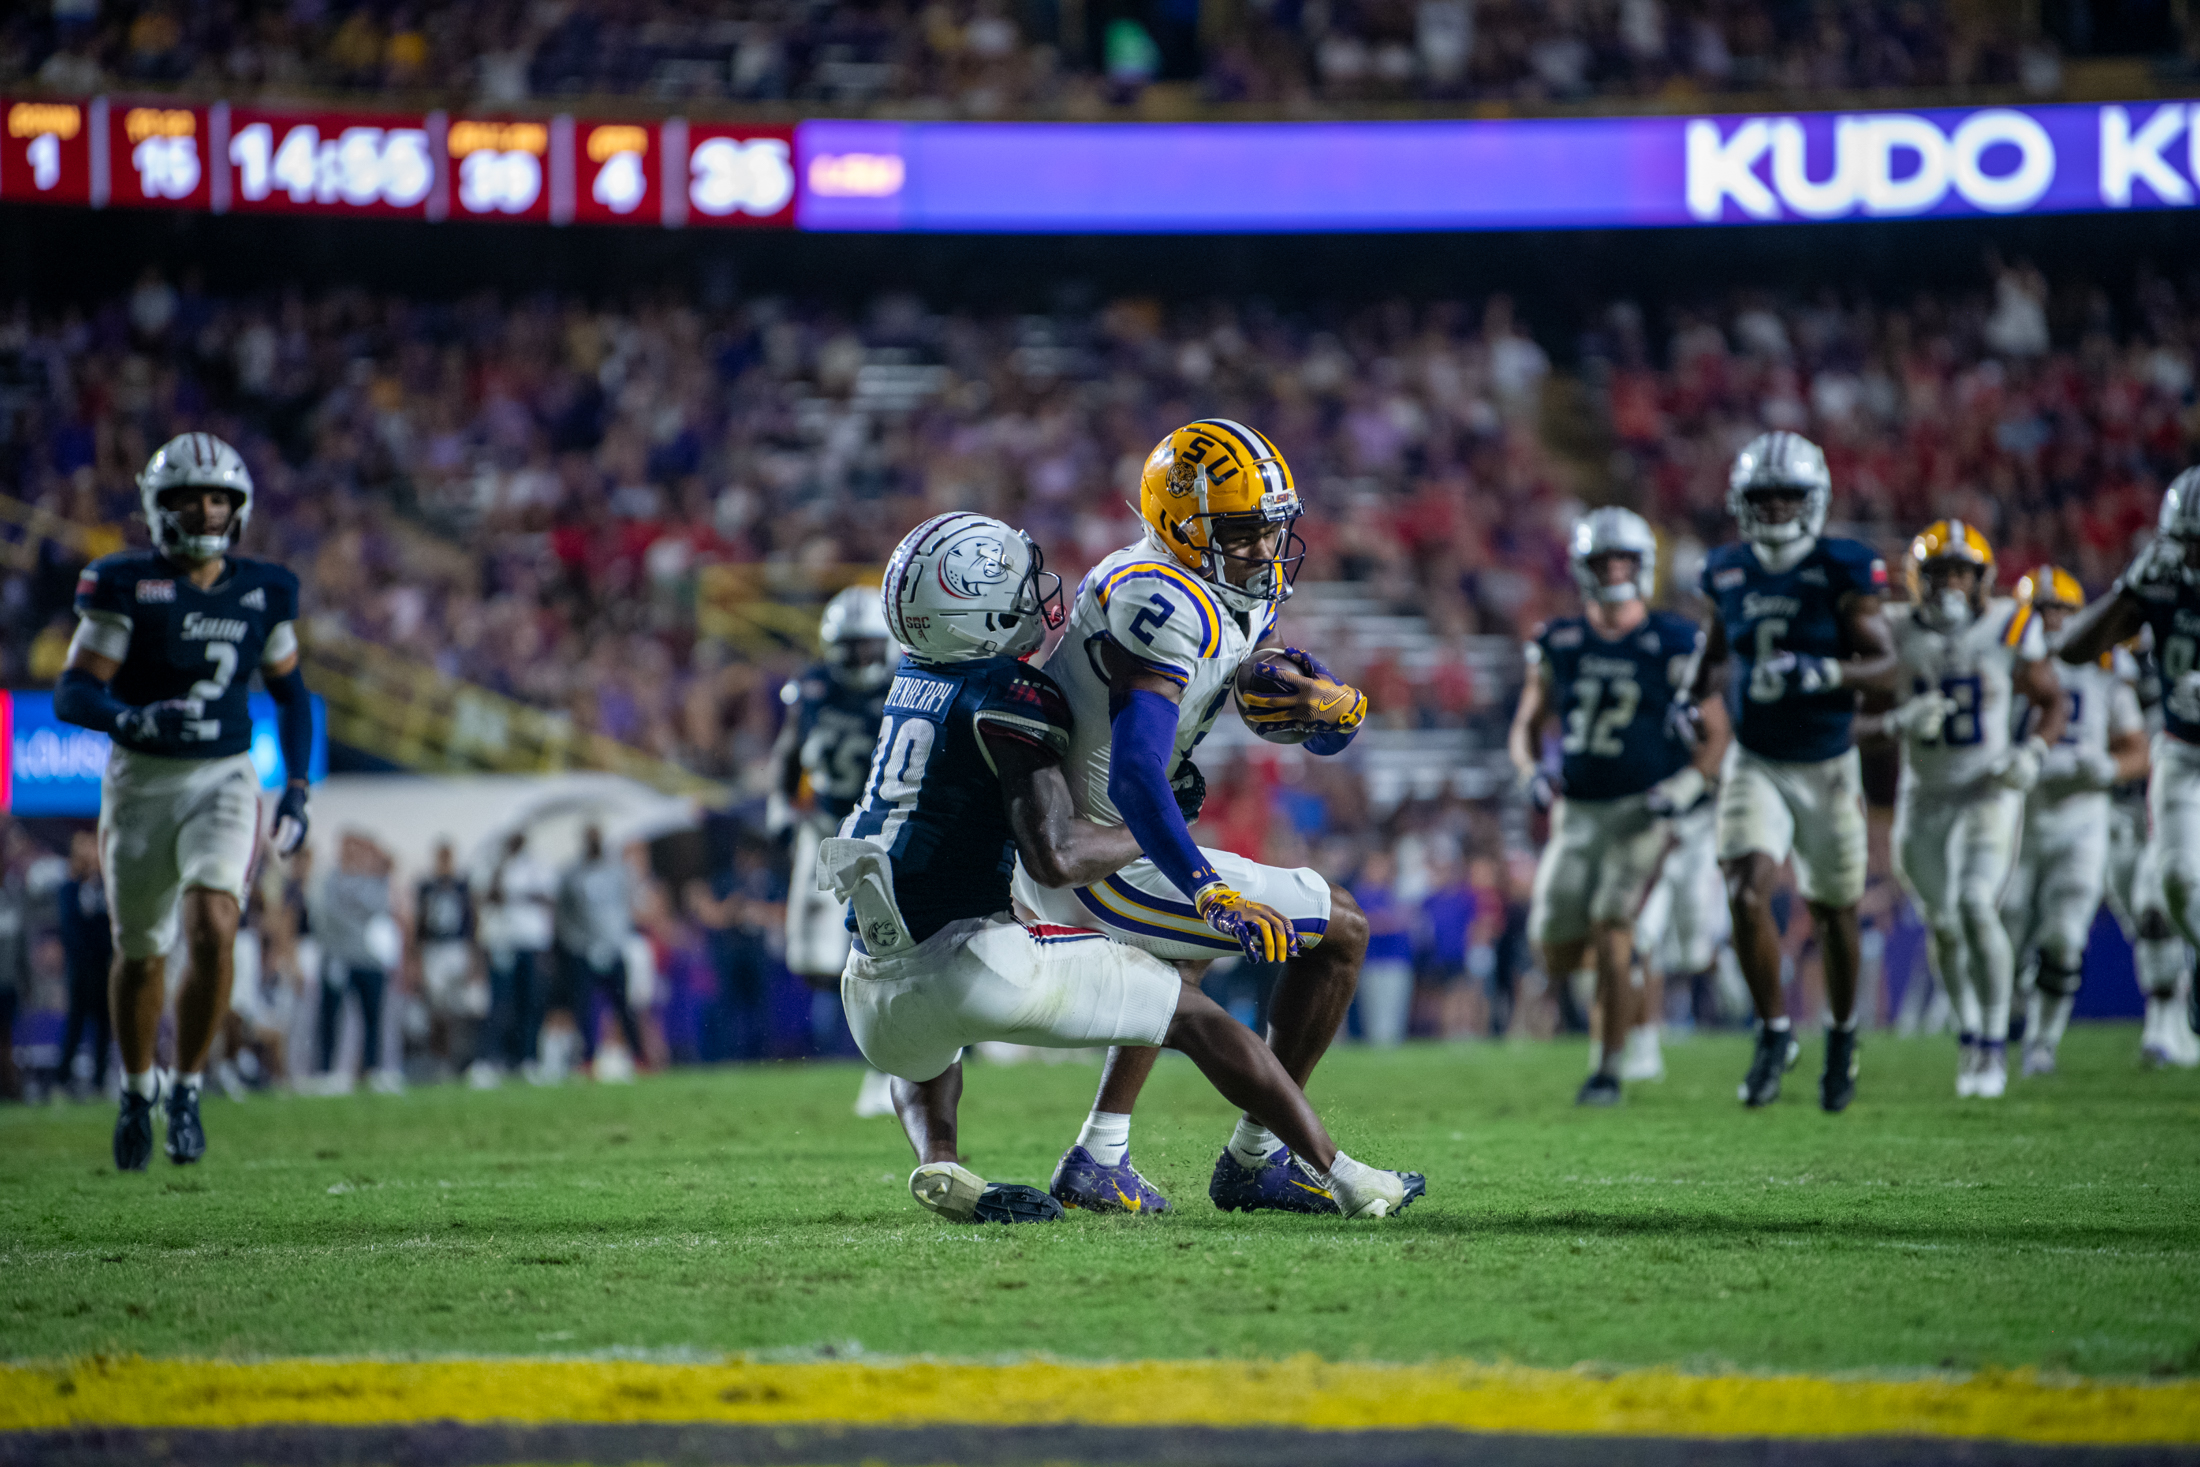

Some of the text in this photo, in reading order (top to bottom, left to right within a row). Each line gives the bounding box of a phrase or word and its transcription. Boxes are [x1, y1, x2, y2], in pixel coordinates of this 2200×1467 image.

[27, 133, 60, 190] 1
[1686, 108, 2056, 222] KUDO
[905, 616, 931, 629] SBC
[1128, 593, 1176, 647] 2
[184, 641, 239, 741] 2
